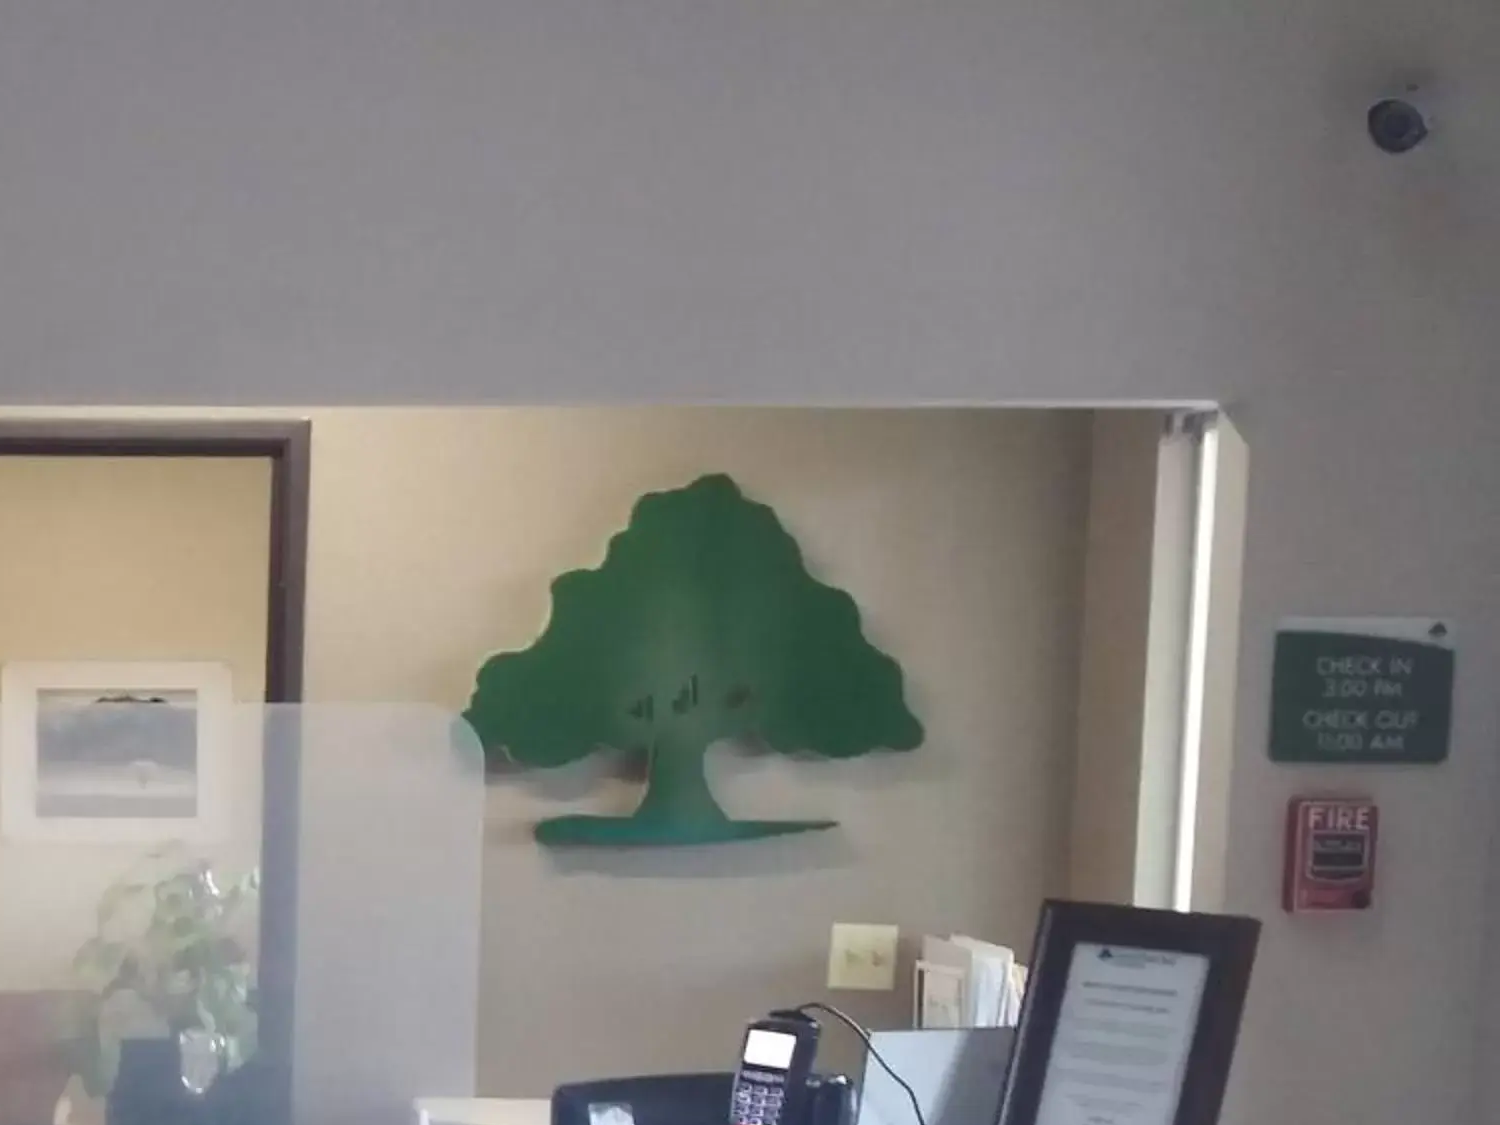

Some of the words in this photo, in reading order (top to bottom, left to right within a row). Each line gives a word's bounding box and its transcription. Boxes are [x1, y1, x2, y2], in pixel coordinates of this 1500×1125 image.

[1317, 656, 1382, 675] CHECK
[1389, 657, 1413, 675] IN
[1302, 710, 1368, 729] CHECK
[1369, 733, 1405, 751] AM
[1308, 805, 1371, 829] FIRE
